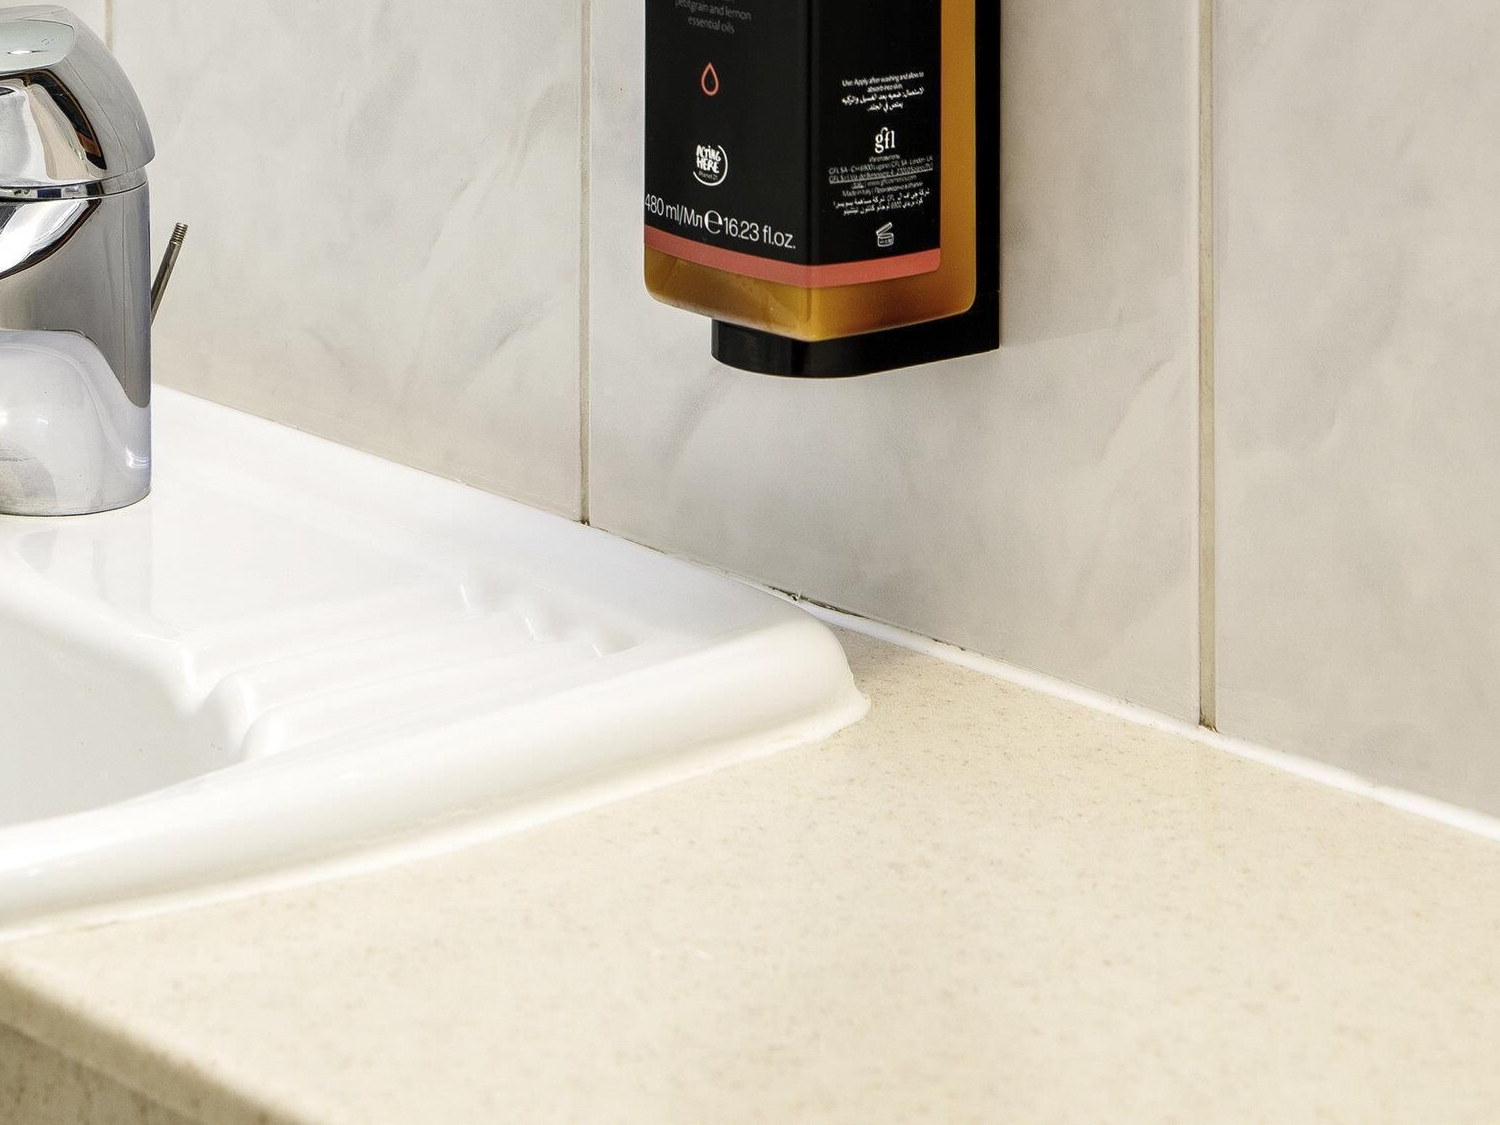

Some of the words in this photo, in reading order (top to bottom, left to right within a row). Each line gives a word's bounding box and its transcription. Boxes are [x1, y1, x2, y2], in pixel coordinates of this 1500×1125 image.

[709, 4, 724, 16] and
[725, 7, 752, 21] lemon
[688, 15, 720, 31] essential
[721, 22, 735, 35] oils
[874, 126, 896, 154] gfl
[696, 156, 720, 174] HERE
[644, 194, 664, 216] 480
[724, 217, 760, 242] 16.23
[763, 225, 796, 249] fl.oz.
